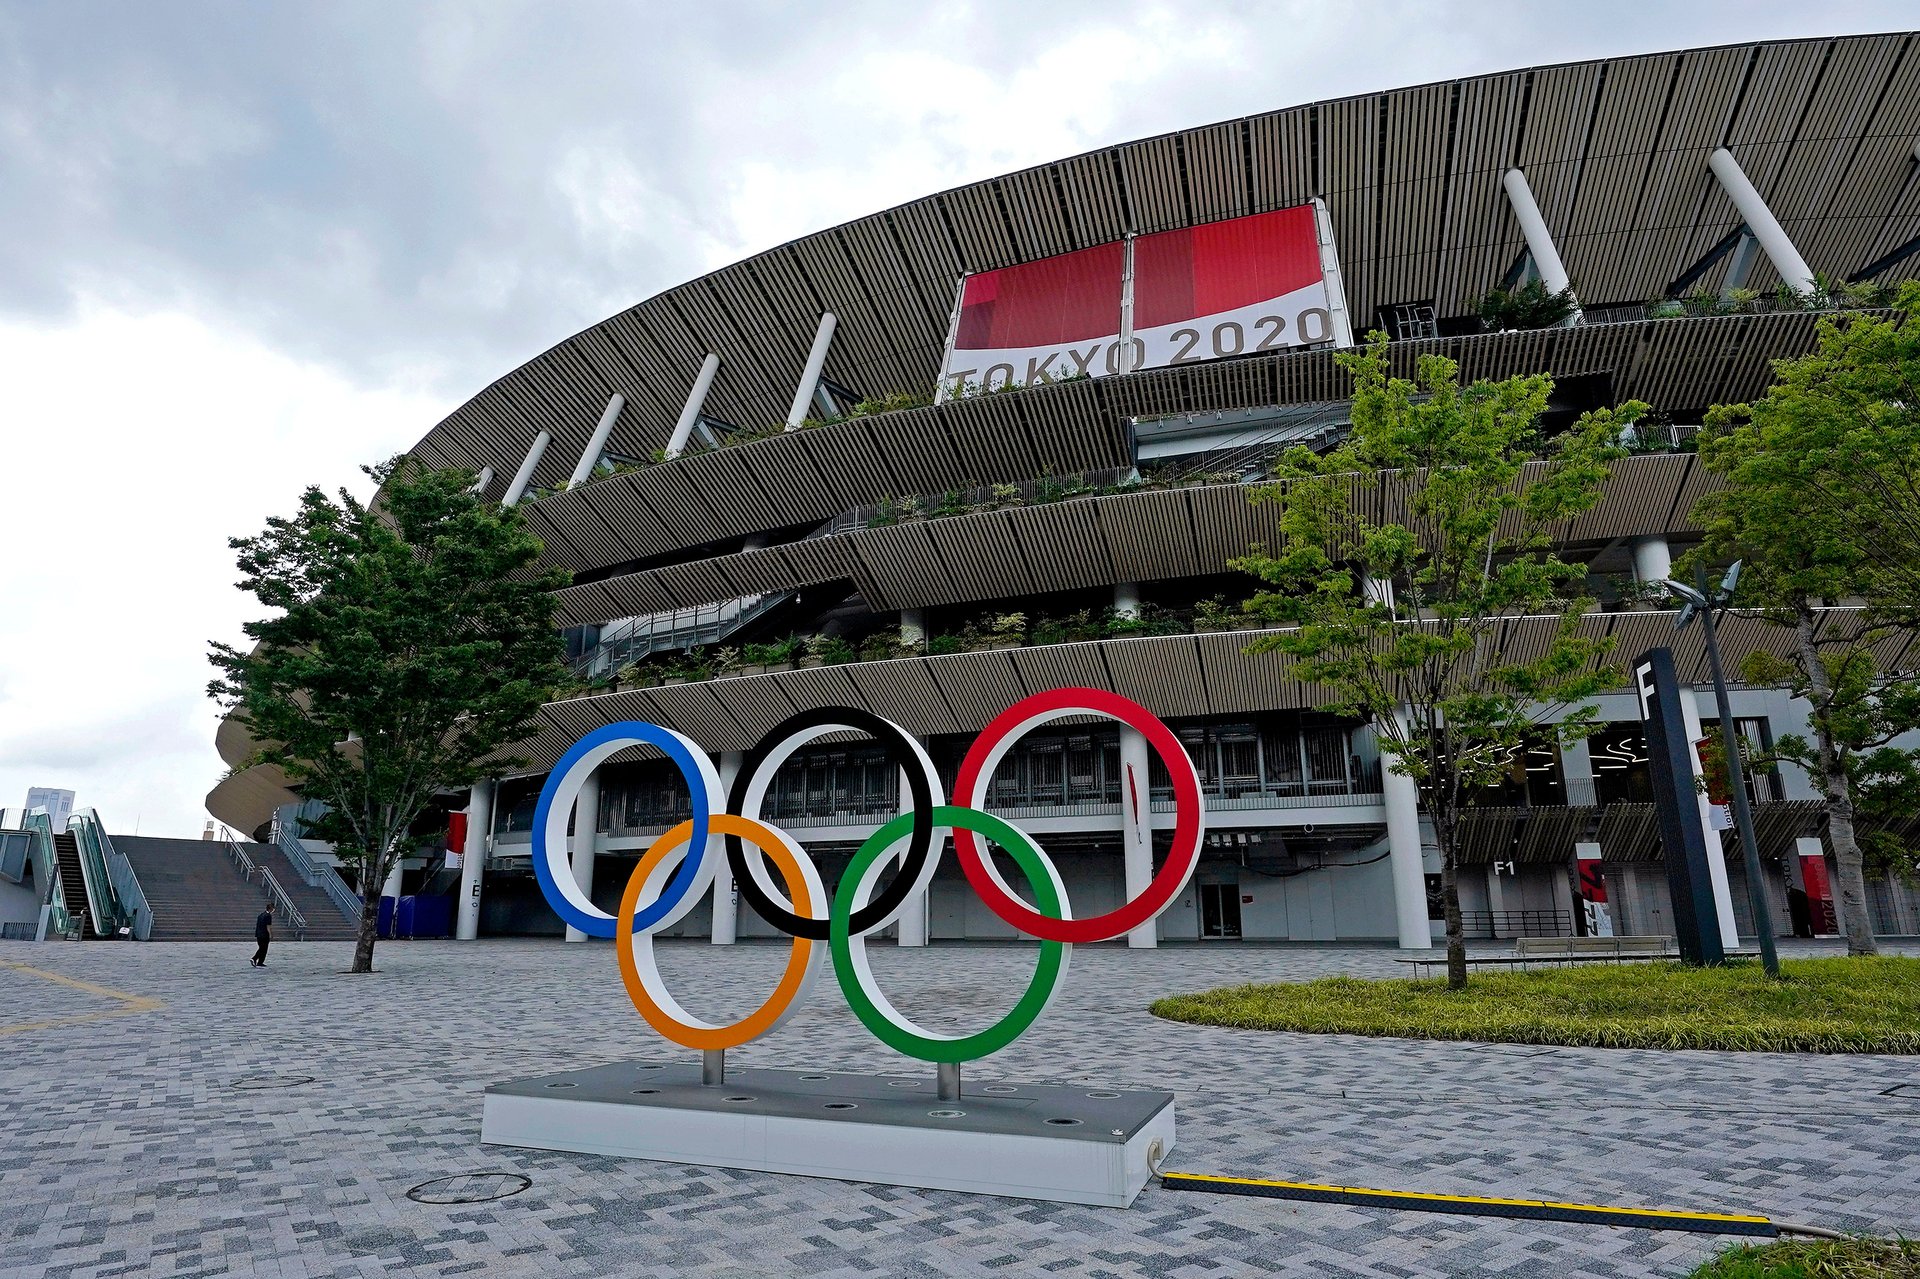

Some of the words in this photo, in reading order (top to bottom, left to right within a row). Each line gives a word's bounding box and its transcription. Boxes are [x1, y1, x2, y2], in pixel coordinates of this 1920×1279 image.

[950, 337, 1145, 395] TOKYO
[1169, 307, 1331, 365] 2020
[1636, 661, 1655, 720] F
[1494, 861, 1515, 875] F1
[472, 885, 480, 897] E
